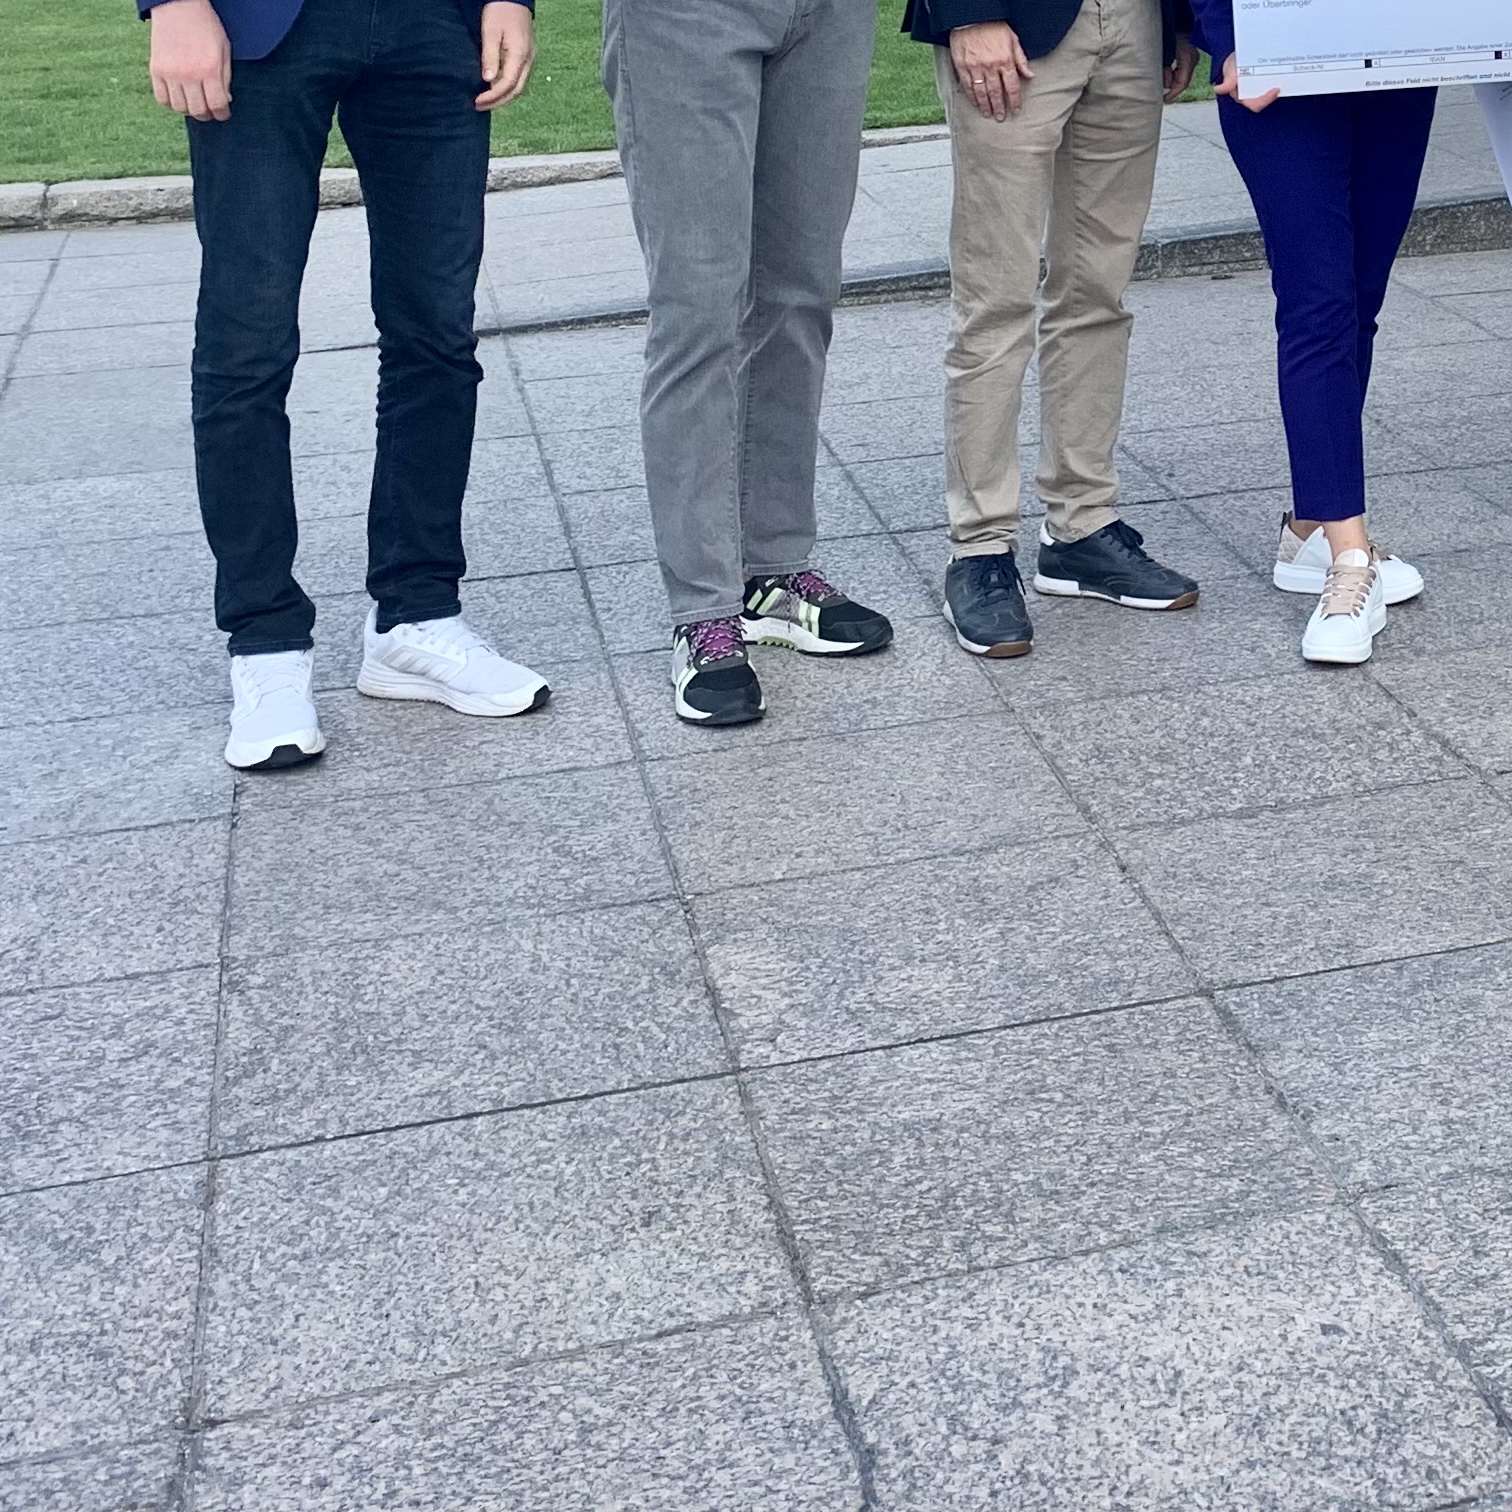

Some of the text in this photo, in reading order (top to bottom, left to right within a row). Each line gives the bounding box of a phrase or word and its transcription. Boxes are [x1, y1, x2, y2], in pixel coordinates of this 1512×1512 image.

[1241, 0, 1312, 10] oder Überbringer
[1440, 74, 1478, 82] beschriften
